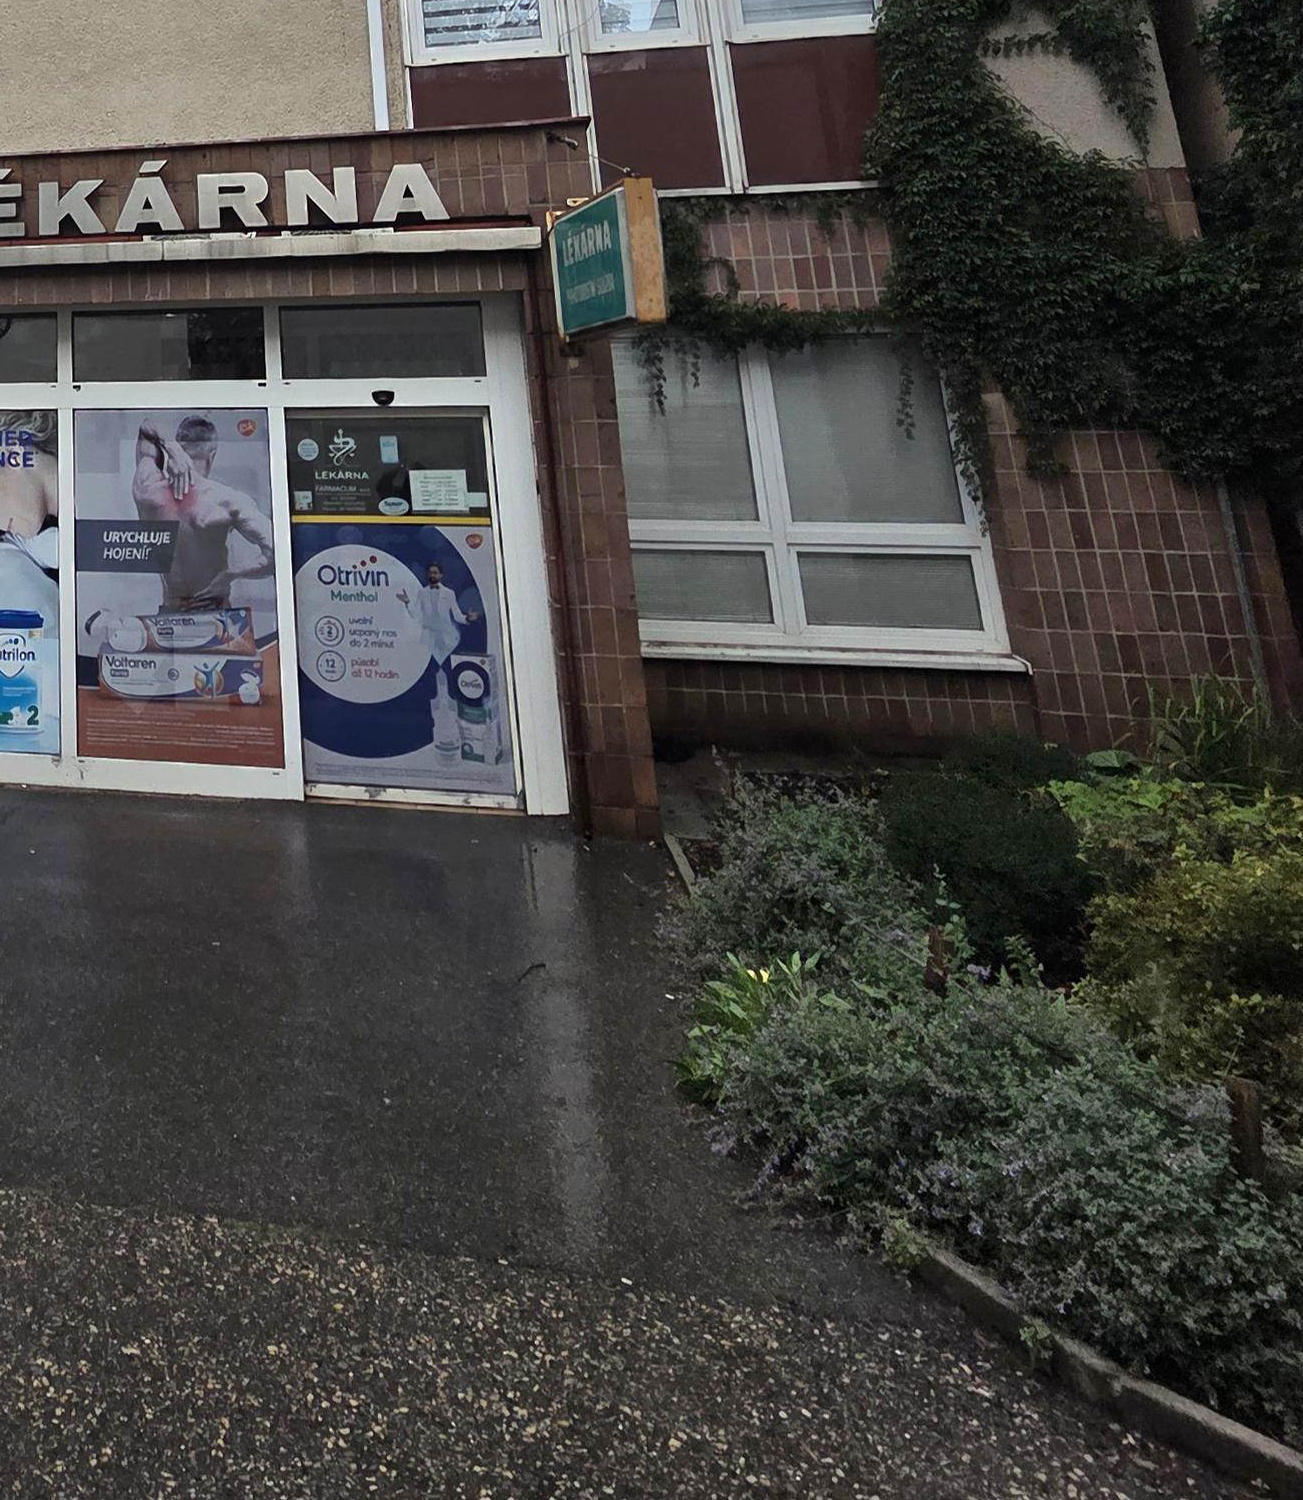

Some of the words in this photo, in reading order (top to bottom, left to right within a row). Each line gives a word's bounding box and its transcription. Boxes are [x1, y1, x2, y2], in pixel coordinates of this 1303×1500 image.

[562, 219, 612, 267] LÉKÁRNA
[102, 531, 171, 546] URYCHLUJE
[316, 562, 390, 587] Otrivin
[330, 589, 379, 603] Menthol
[349, 638, 362, 648] do
[363, 639, 370, 648] 2
[371, 638, 395, 649] minut
[105, 655, 157, 670] Voltaren
[325, 658, 337, 669] 12
[364, 669, 374, 678] 12
[374, 668, 399, 680] hodin
[26, 705, 40, 726] 2
